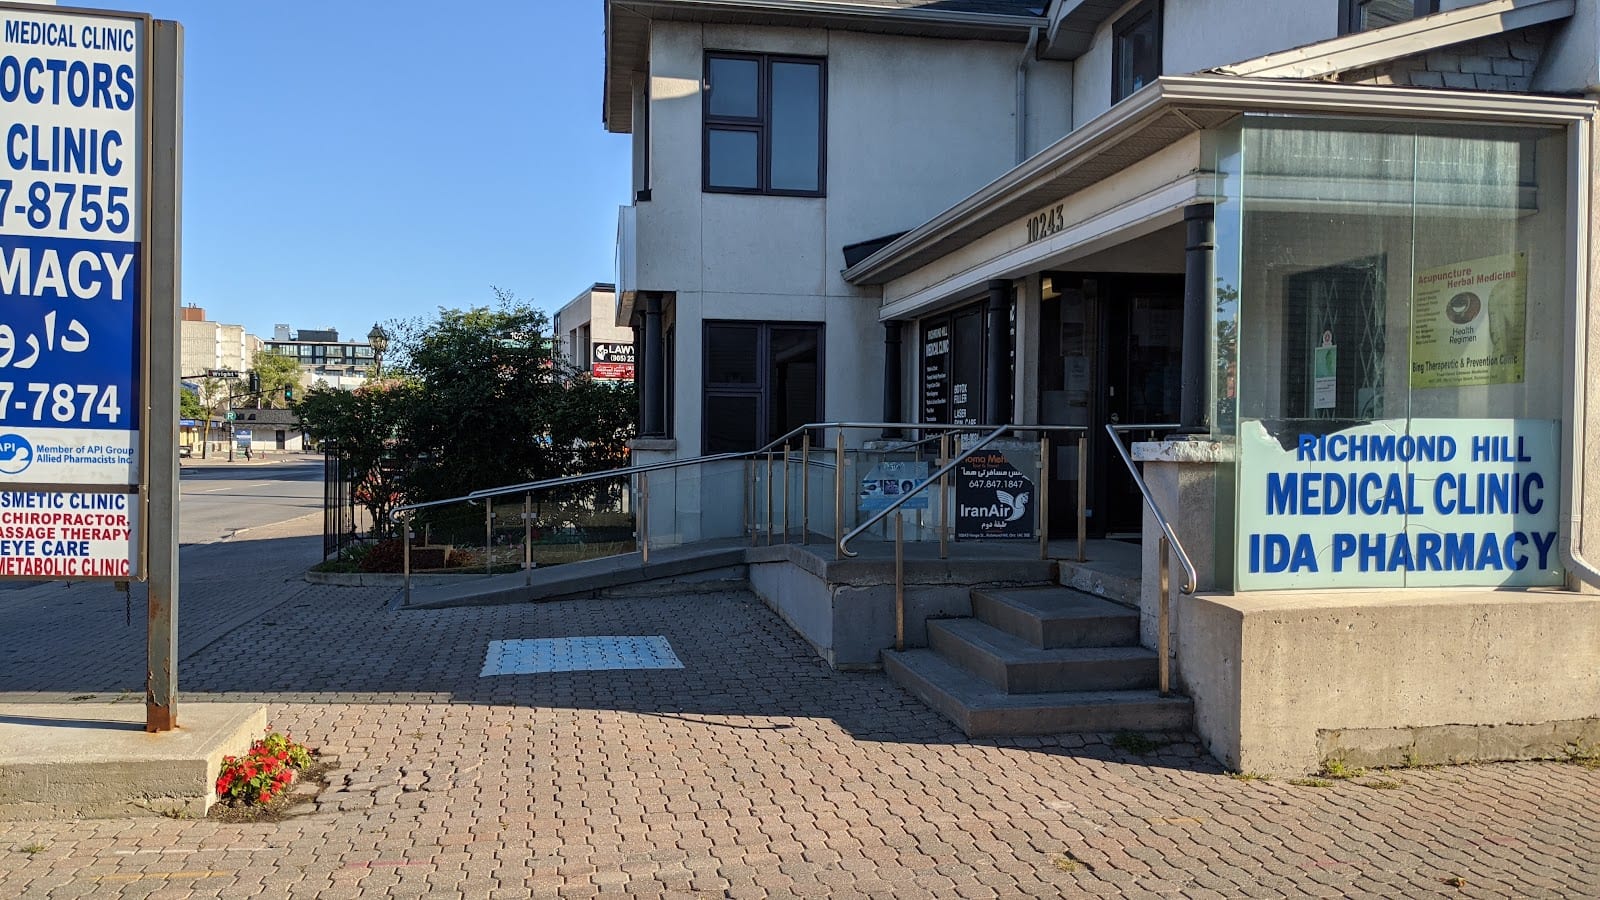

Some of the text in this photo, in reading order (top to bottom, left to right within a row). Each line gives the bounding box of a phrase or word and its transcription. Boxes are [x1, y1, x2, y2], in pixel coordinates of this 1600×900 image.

[5, 20, 134, 52] MEDICAL CLINIC
[0, 55, 135, 111] OCTORS
[7, 123, 123, 176] CLINIC
[0, 179, 130, 234] 7-8755
[1026, 204, 1064, 243] 10243
[0, 247, 134, 300] MACY
[1418, 267, 1472, 285] Acupuncture
[1447, 269, 1517, 289] Herbal Medicine
[1450, 335, 1477, 345] Regimen
[1452, 326, 1474, 336] Health
[1425, 358, 1459, 371] Therapeutic
[1466, 356, 1498, 368] Prevention
[0, 382, 121, 423] 7-7874
[954, 409, 966, 418] LASER
[36, 445, 134, 456] Member of API Group
[1297, 434, 1531, 463] RICHMOND HILL
[36, 455, 133, 464] Allied Pharmacists Inc.
[969, 480, 1023, 488] 647.847.1847
[1266, 471, 1544, 516] MEDICAL CLINIC
[1, 491, 125, 510] SMETIC CLINIC
[2, 512, 130, 526] CHIROPRACTOR,
[960, 504, 1011, 517] IranAir
[61, 528, 132, 541] THERAPY
[0, 540, 89, 556] EYE CARE
[1249, 531, 1557, 573] IDA PHARMACY
[81, 558, 130, 577] CLINIC
